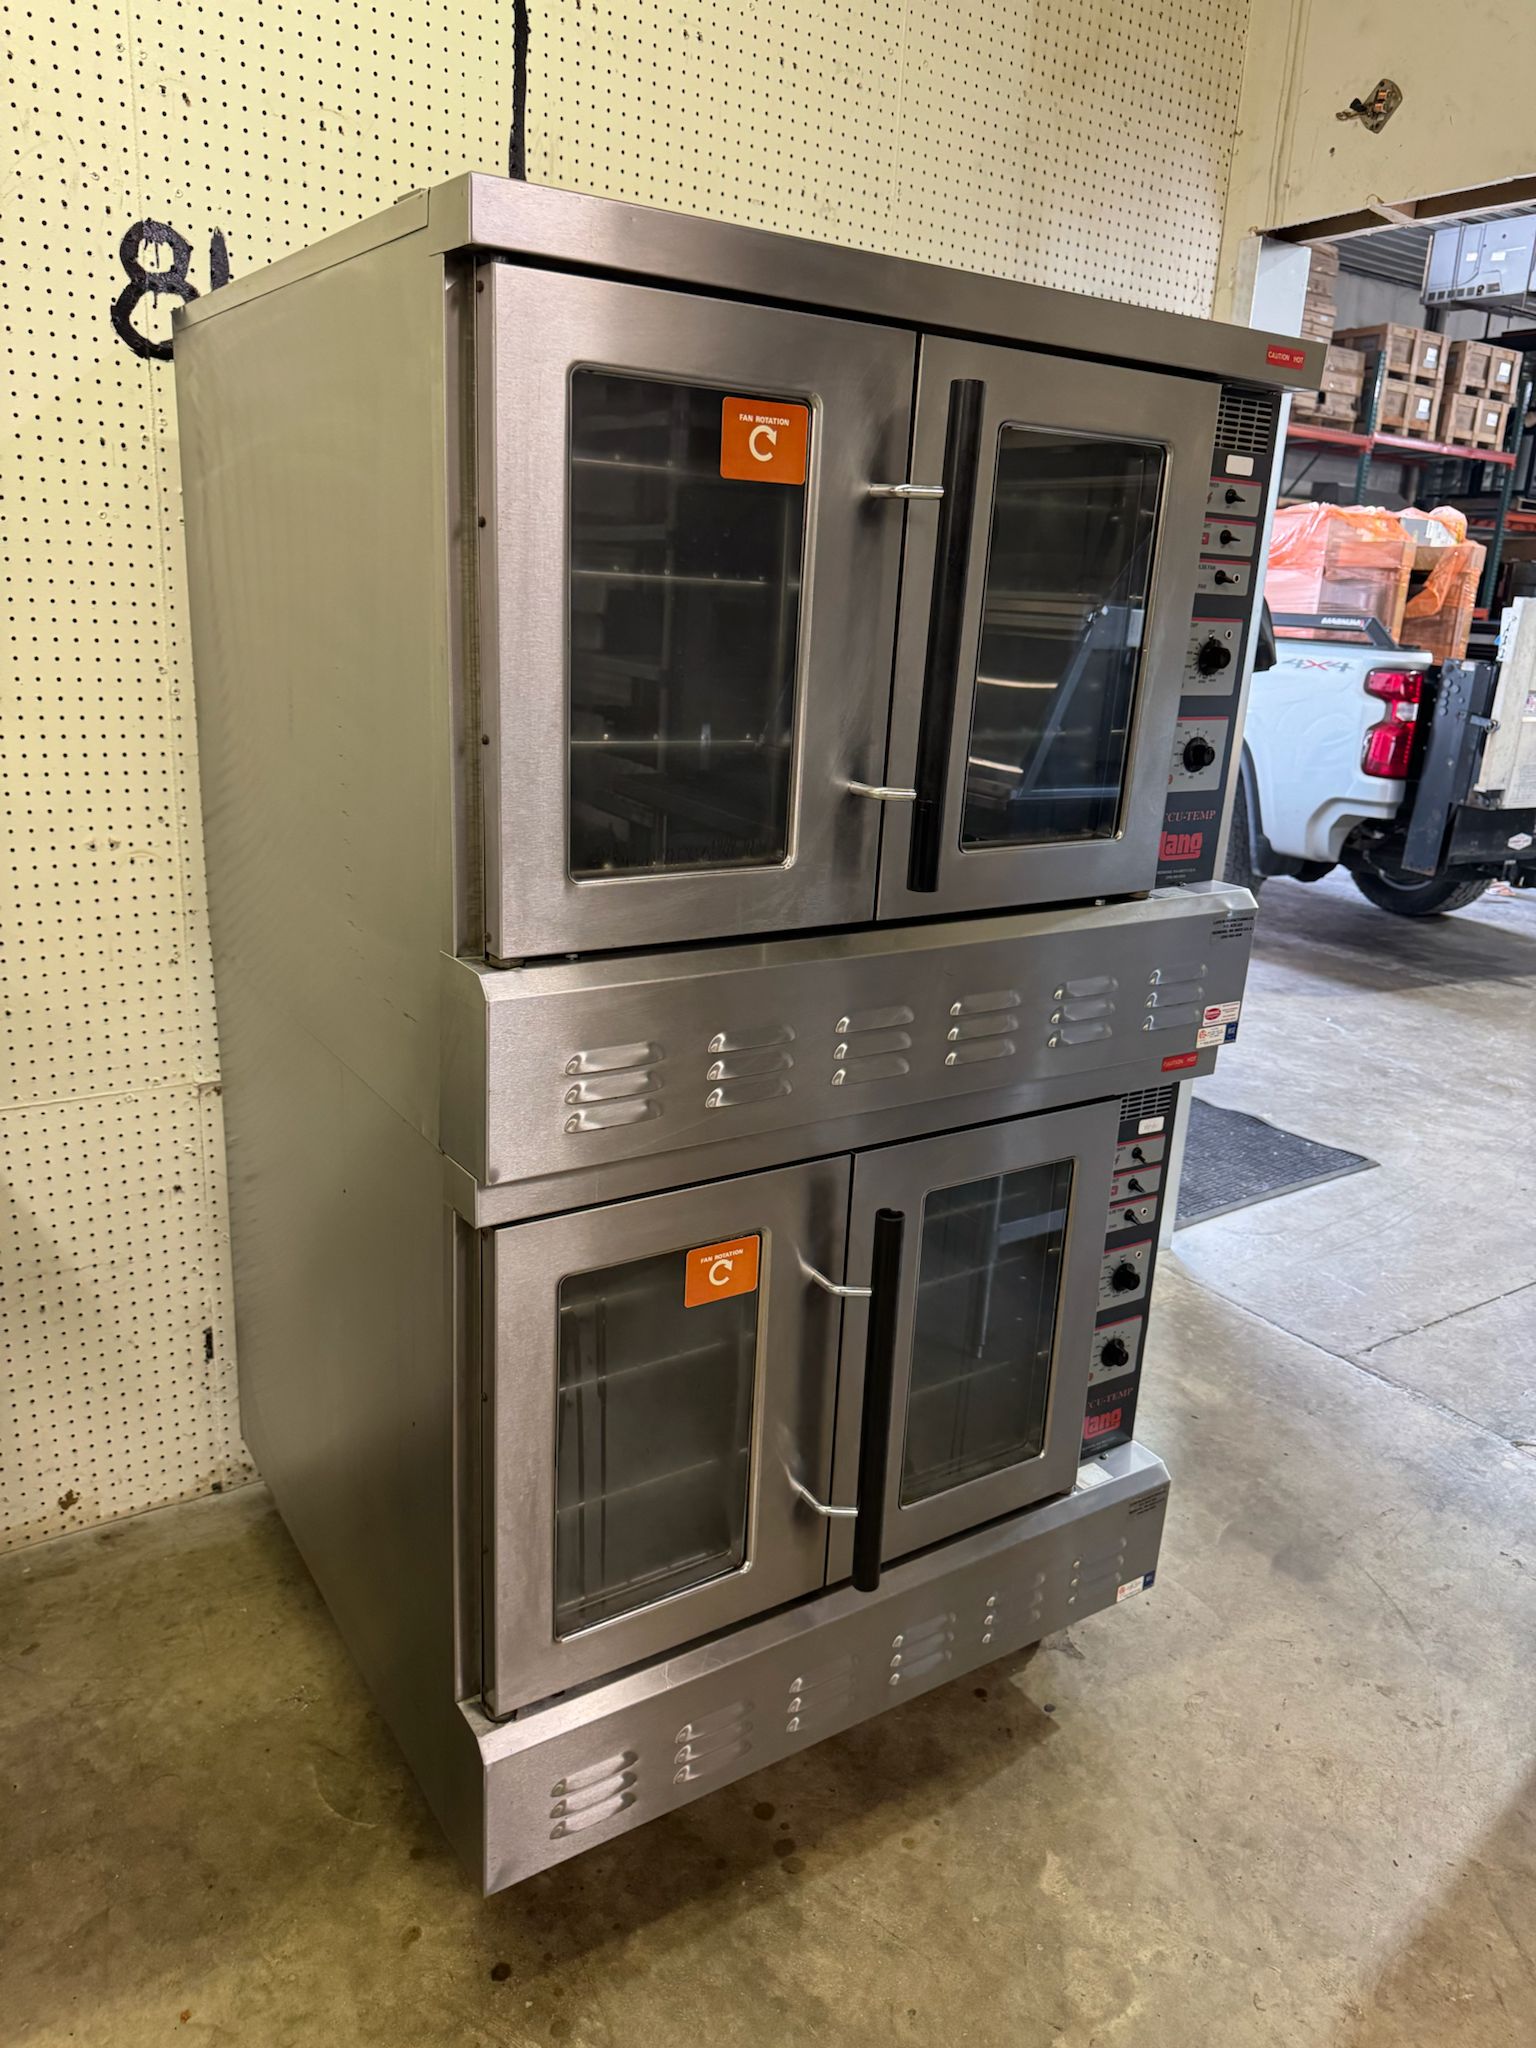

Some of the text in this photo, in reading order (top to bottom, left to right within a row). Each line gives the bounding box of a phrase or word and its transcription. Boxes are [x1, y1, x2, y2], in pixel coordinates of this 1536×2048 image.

[1268, 351, 1304, 364] CAUTION HOT
[739, 413, 790, 427] FAN ROTATION
[1166, 809, 1217, 823] CU-TEMP
[700, 1248, 744, 1265] FAN ROTATION
[1088, 1386, 1134, 1409] CU-TEMP
